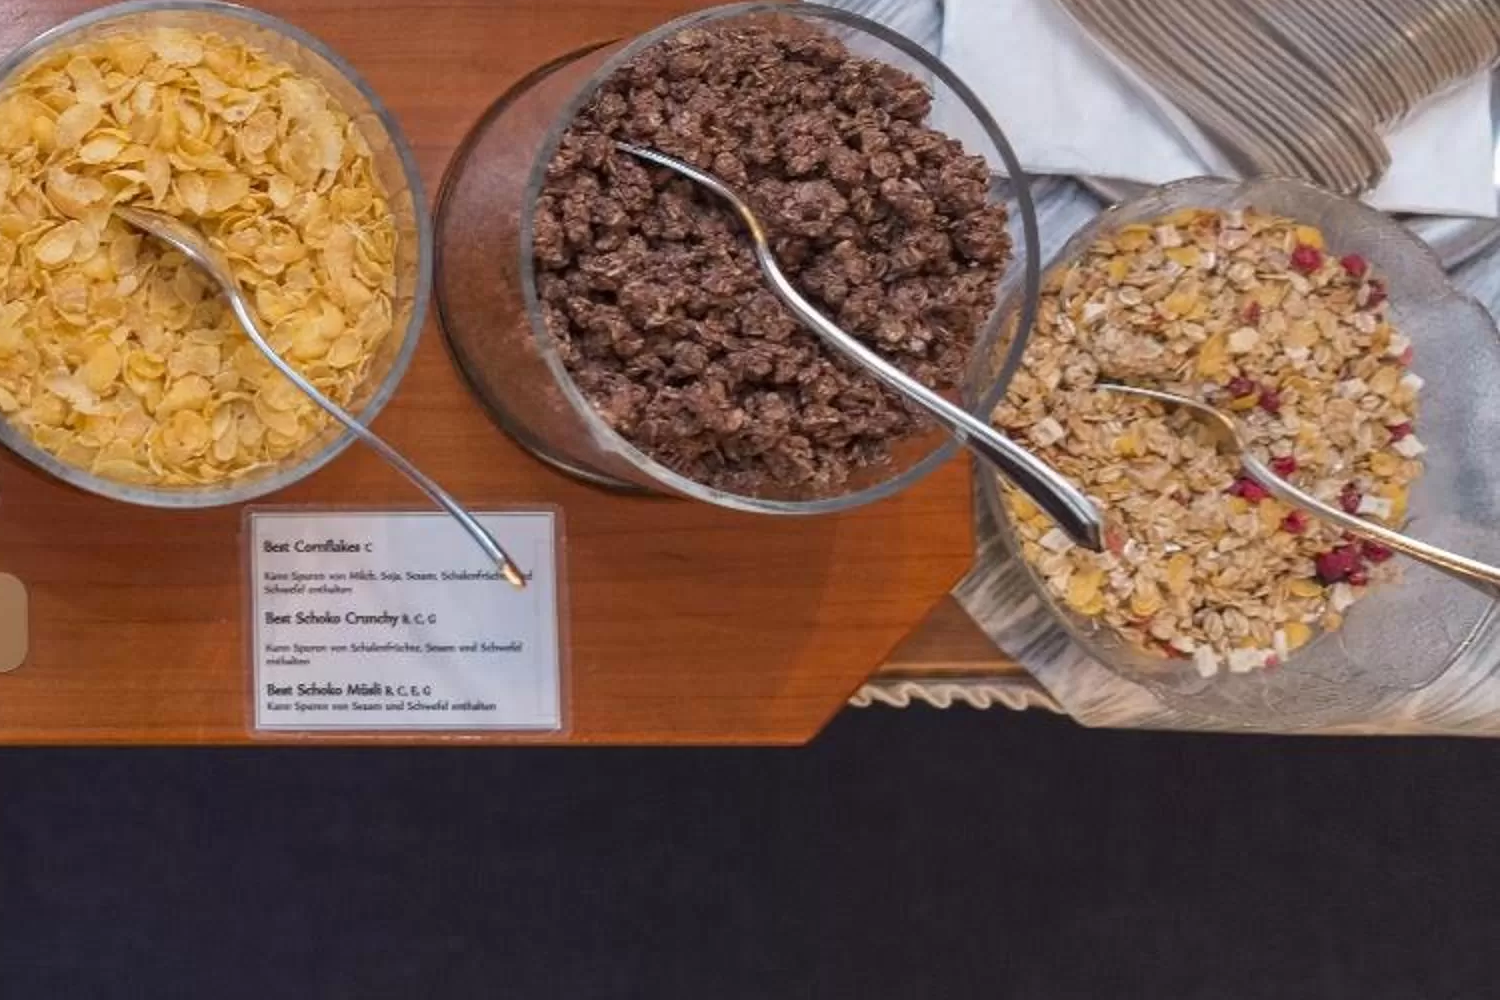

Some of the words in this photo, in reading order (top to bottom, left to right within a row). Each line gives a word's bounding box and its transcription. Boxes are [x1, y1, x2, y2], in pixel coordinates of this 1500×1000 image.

[264, 540, 290, 552] Best
[266, 612, 291, 624] Best
[267, 684, 292, 696] Best
